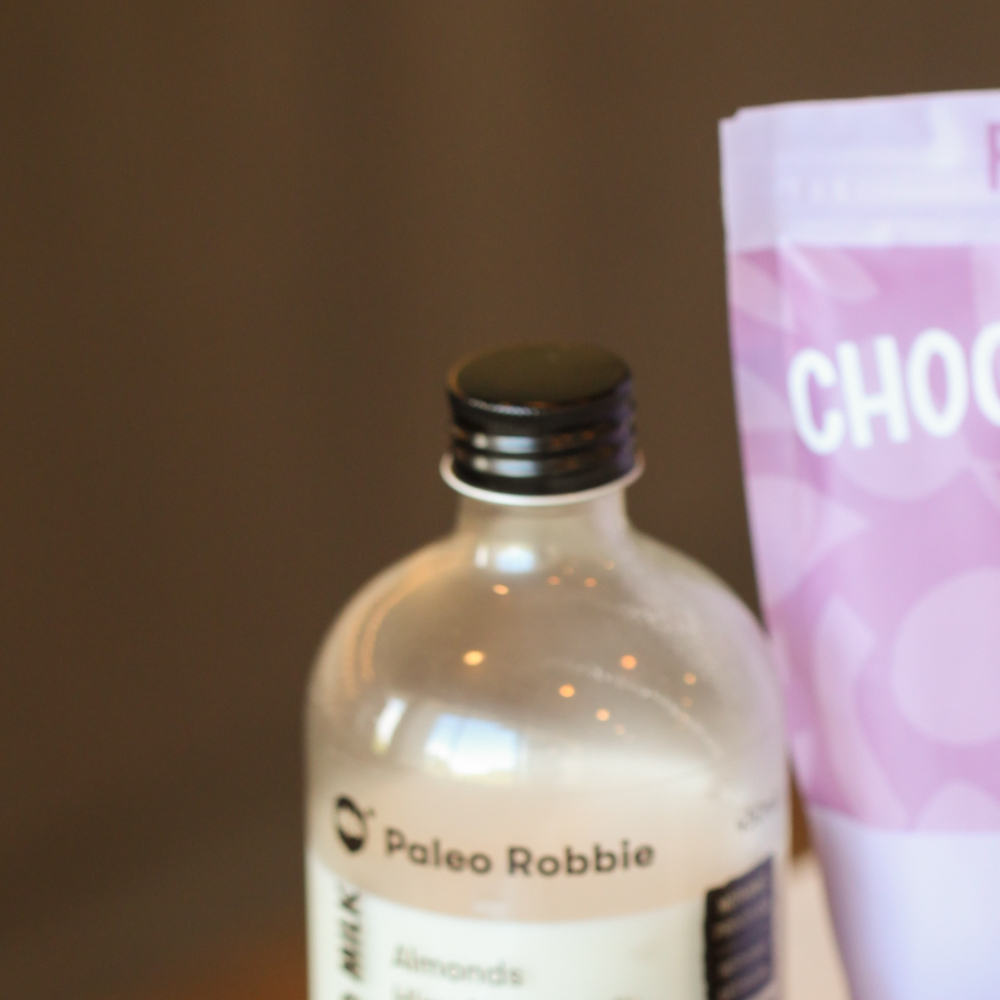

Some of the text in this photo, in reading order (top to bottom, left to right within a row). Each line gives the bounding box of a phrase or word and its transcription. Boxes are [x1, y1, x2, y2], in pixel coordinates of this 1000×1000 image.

[385, 828, 656, 877] Paleo Robbie
[338, 880, 366, 984] MILK
[393, 944, 525, 987] Almonds
